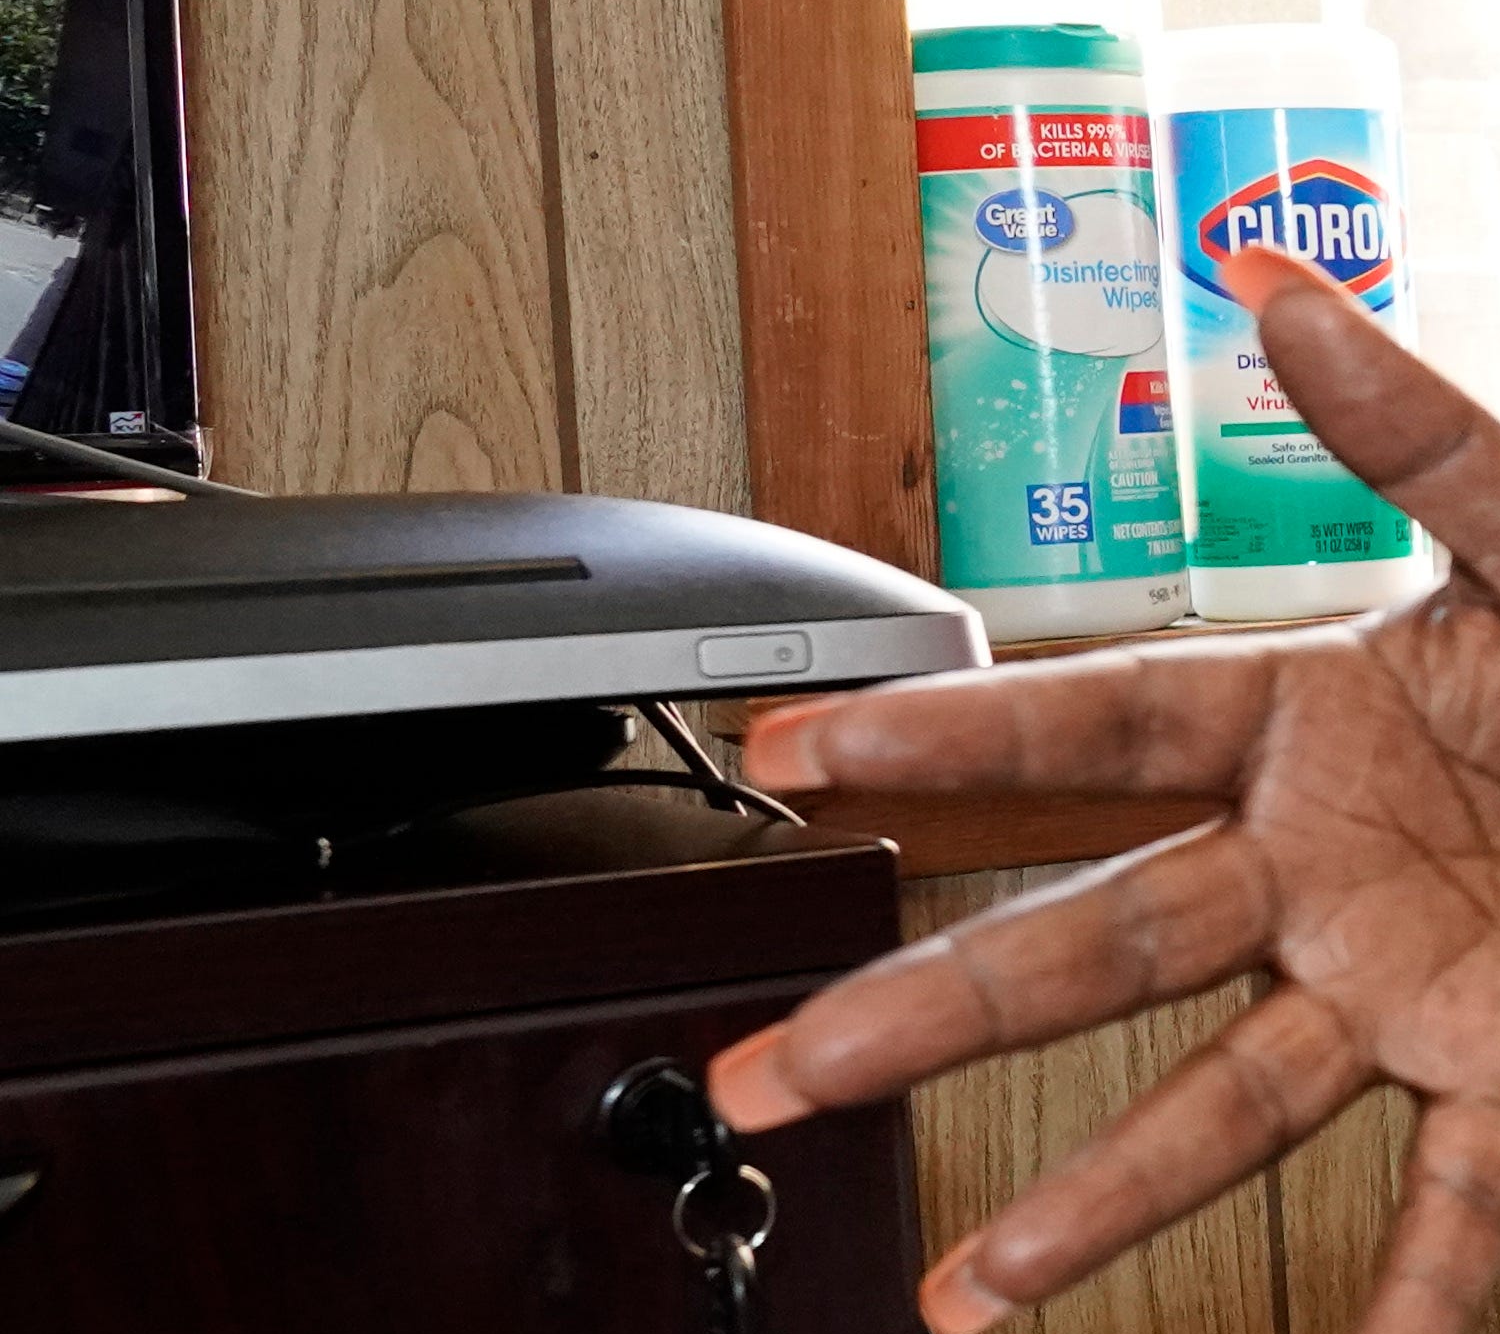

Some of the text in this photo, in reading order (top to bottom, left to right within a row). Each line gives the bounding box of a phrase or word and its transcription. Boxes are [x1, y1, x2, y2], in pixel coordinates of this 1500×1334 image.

[1040, 123, 1127, 140] KILLS 99.9%
[980, 143, 1006, 159] OF
[1102, 141, 1113, 157] &
[1002, 223, 1058, 238] Vaue
[1102, 287, 1158, 312] Wipes
[1237, 353, 1267, 369] Dis
[1271, 442, 1297, 453] Safe
[1299, 443, 1314, 452] on
[1248, 454, 1285, 465] Sealed
[1288, 453, 1328, 464] Granite
[1110, 470, 1158, 488] CAUTION
[1031, 486, 1089, 526] 35
[1035, 524, 1089, 542] WIPES
[1323, 523, 1344, 538] WET
[1345, 521, 1374, 536] WIPES
